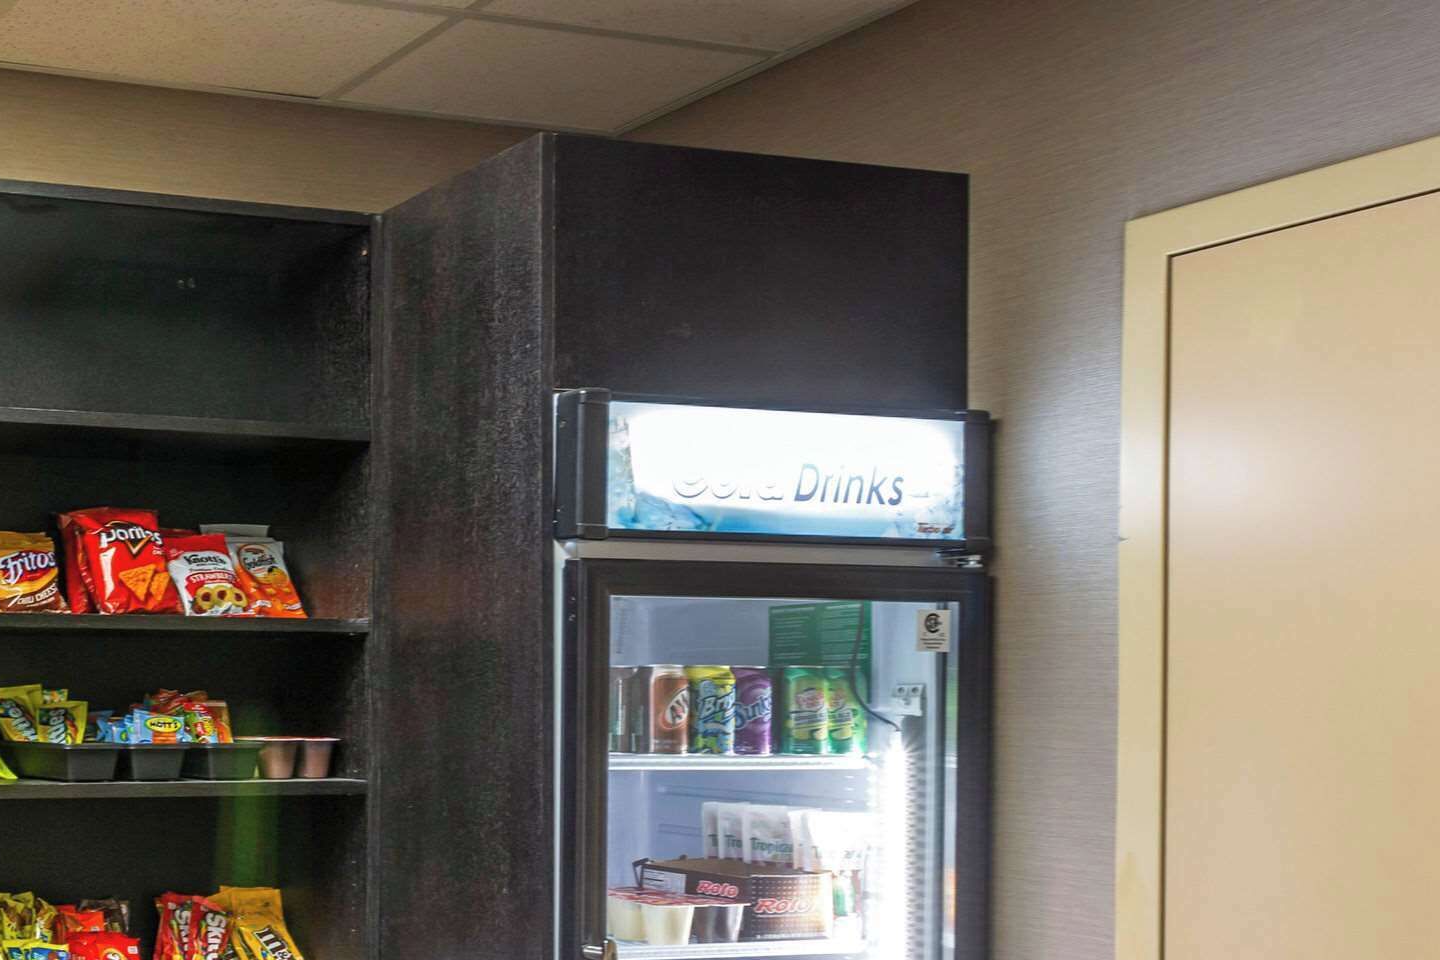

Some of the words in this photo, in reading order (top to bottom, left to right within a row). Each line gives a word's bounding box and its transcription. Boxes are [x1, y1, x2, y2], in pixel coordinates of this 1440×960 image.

[793, 463, 904, 506] Drinks
[100, 524, 163, 549] Doritos
[696, 880, 739, 898] Rolo
[754, 896, 815, 914] Rolo
